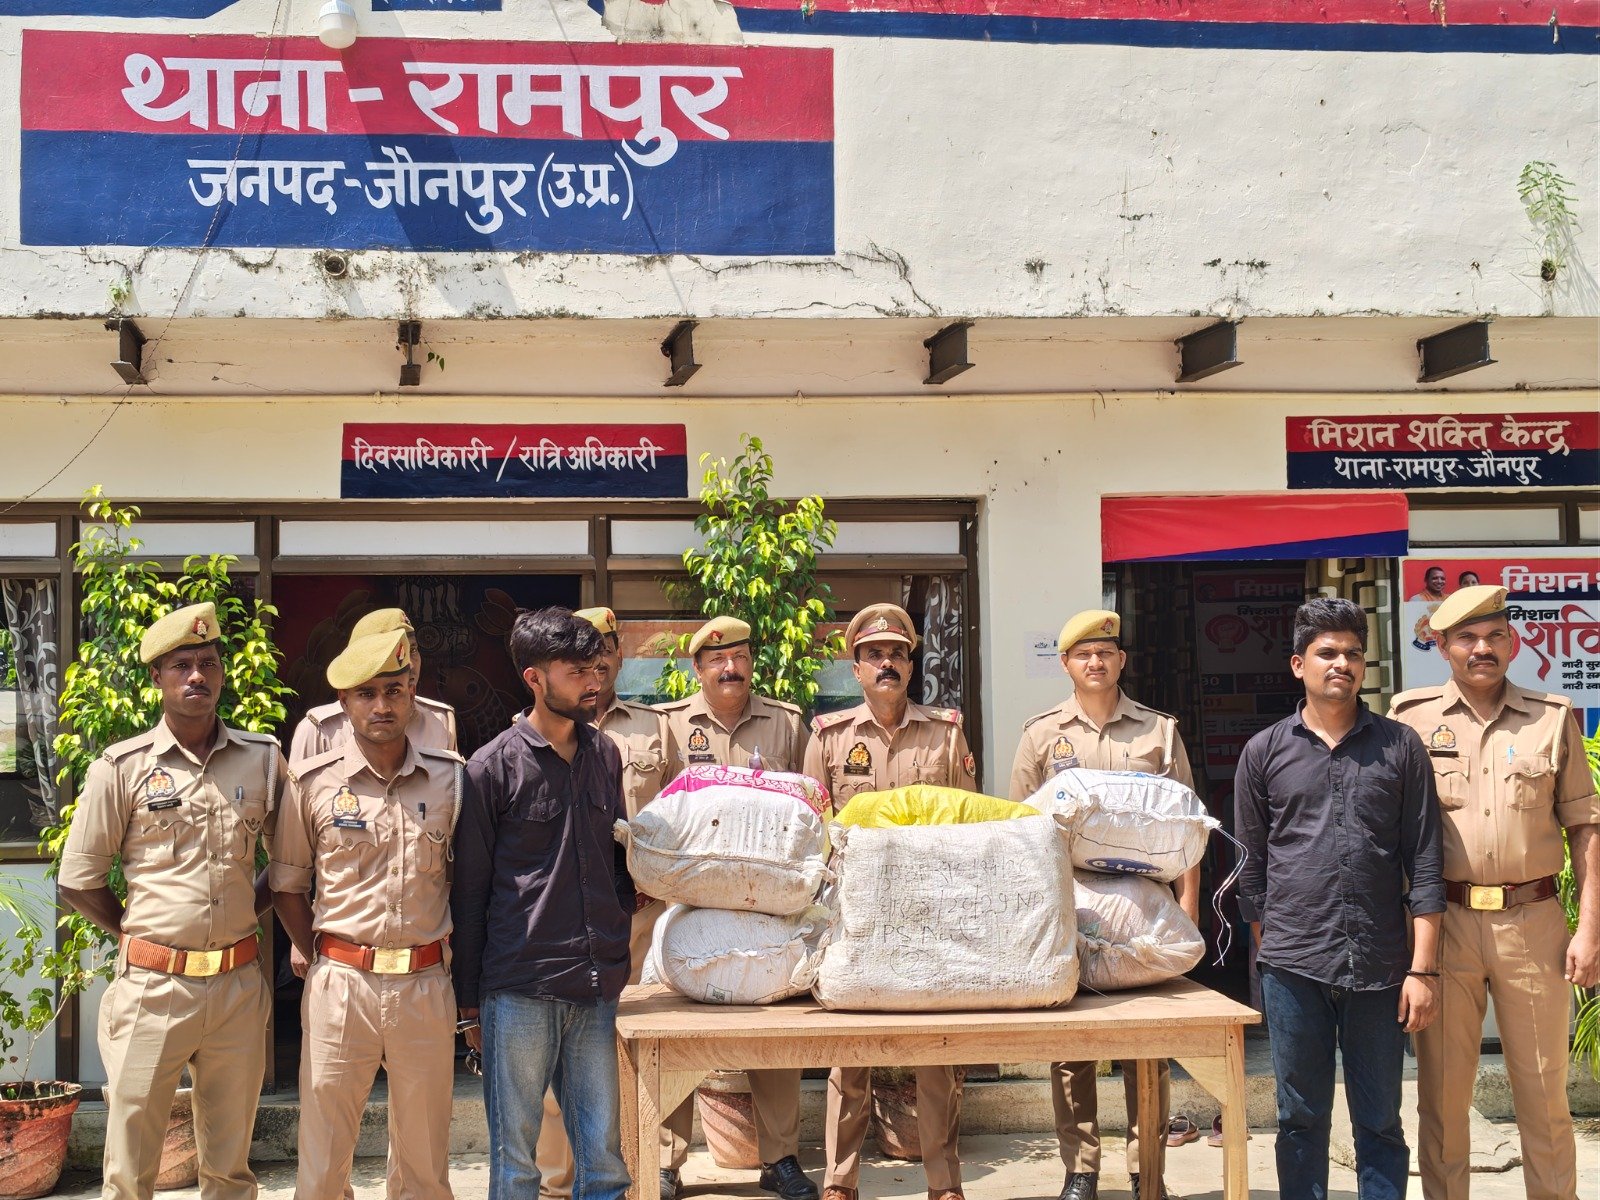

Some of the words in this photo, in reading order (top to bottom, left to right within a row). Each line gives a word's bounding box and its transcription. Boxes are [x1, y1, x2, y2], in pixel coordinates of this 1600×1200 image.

[1306, 418, 1400, 451] मिशन
[1407, 416, 1493, 451] शक्ति
[1500, 414, 1572, 456] केन्द्र
[351, 437, 494, 473] दिवसाधिकारी
[519, 438, 564, 472] रात्रि
[565, 436, 666, 472] अधिकारी
[1500, 565, 1589, 593] मिशन
[1506, 605, 1560, 621] मिशन
[1562, 659, 1583, 669] नारी
[1562, 670, 1583, 680] नारी
[1562, 681, 1583, 690] नारी
